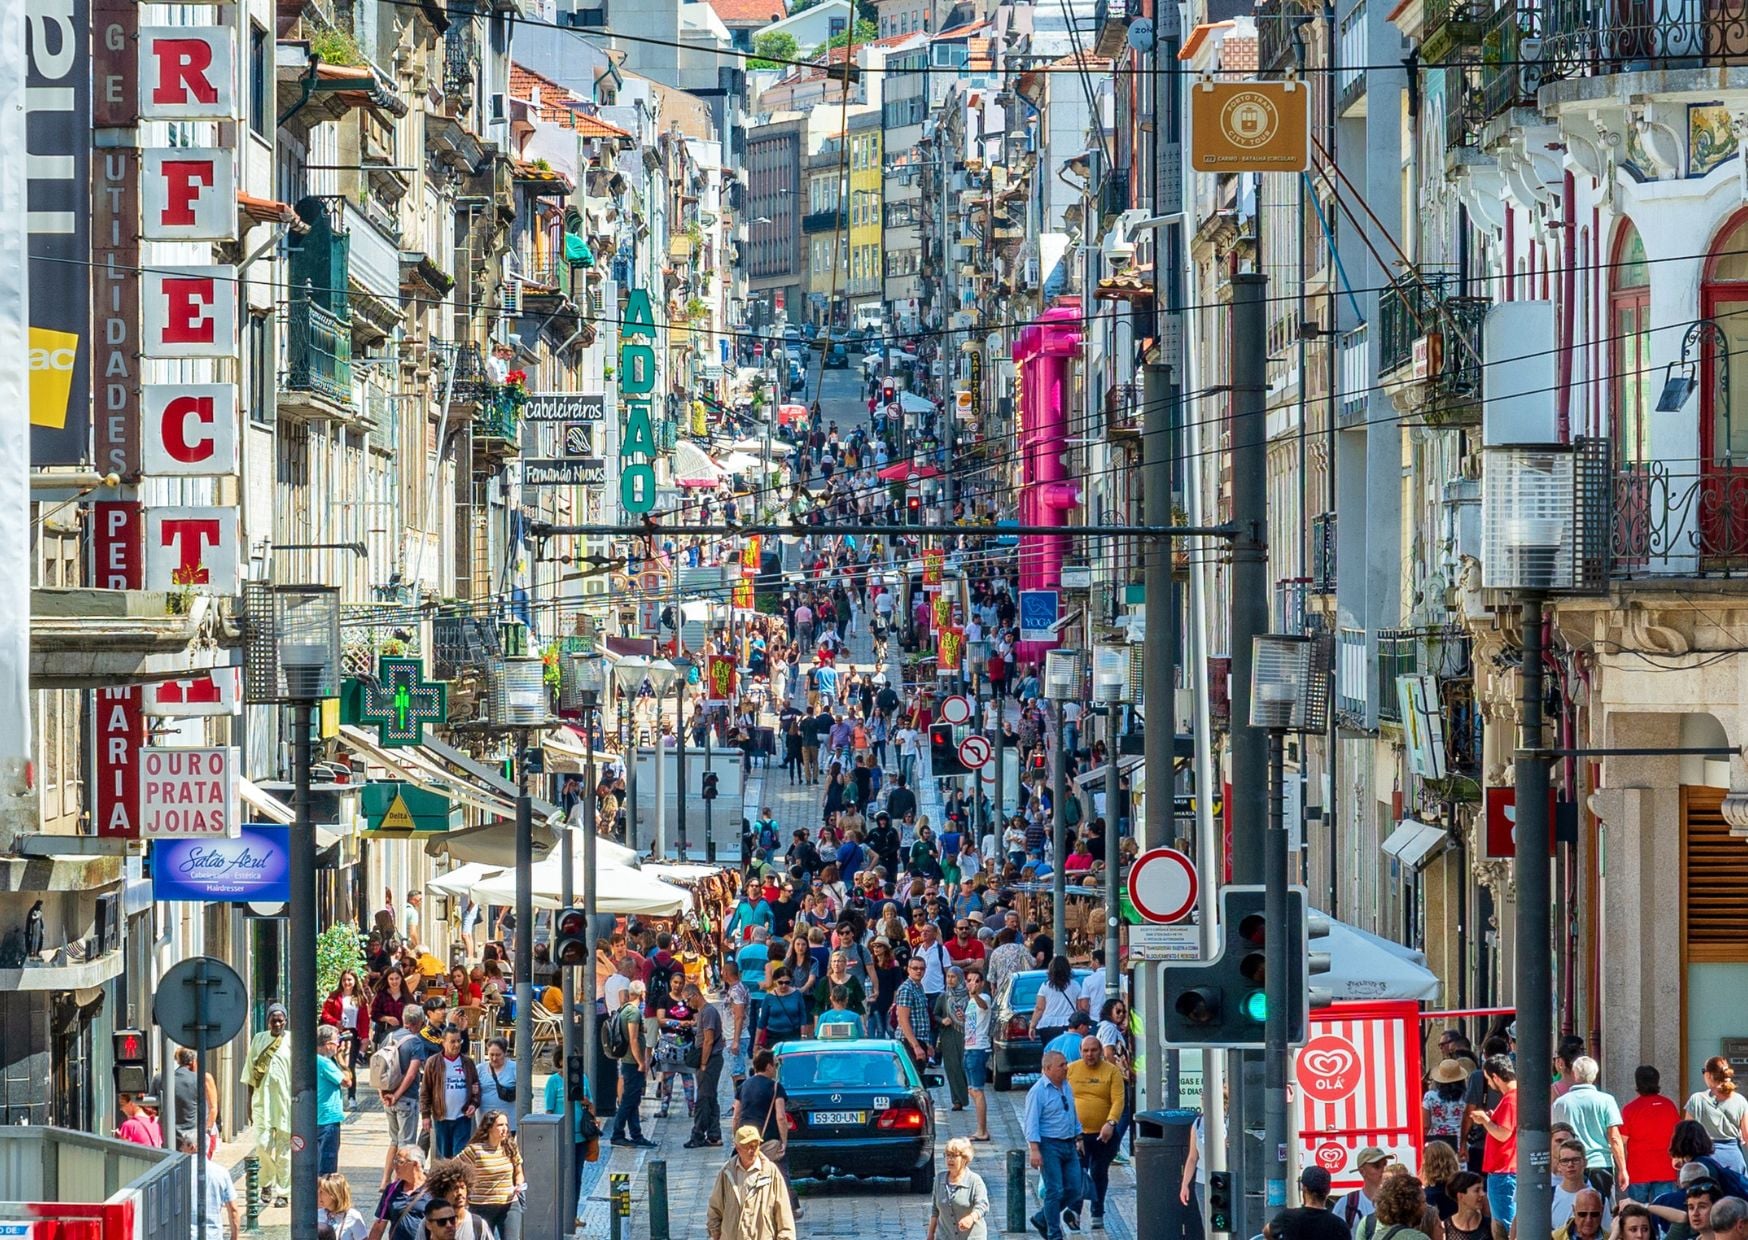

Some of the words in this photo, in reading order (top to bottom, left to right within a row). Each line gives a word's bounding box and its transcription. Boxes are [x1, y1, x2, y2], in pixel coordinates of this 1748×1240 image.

[105, 154, 127, 475] UTILIDADES
[525, 397, 602, 419] Cabeleireiros
[146, 753, 224, 776] OURO
[146, 781, 224, 804] PRATA
[146, 809, 224, 832] JOIAS
[179, 846, 226, 873] Salão
[220, 847, 274, 875] Azul
[206, 884, 245, 893] Hairdresser
[1315, 1076, 1344, 1090] OLÁ
[815, 1113, 859, 1123] 59-30-UN
